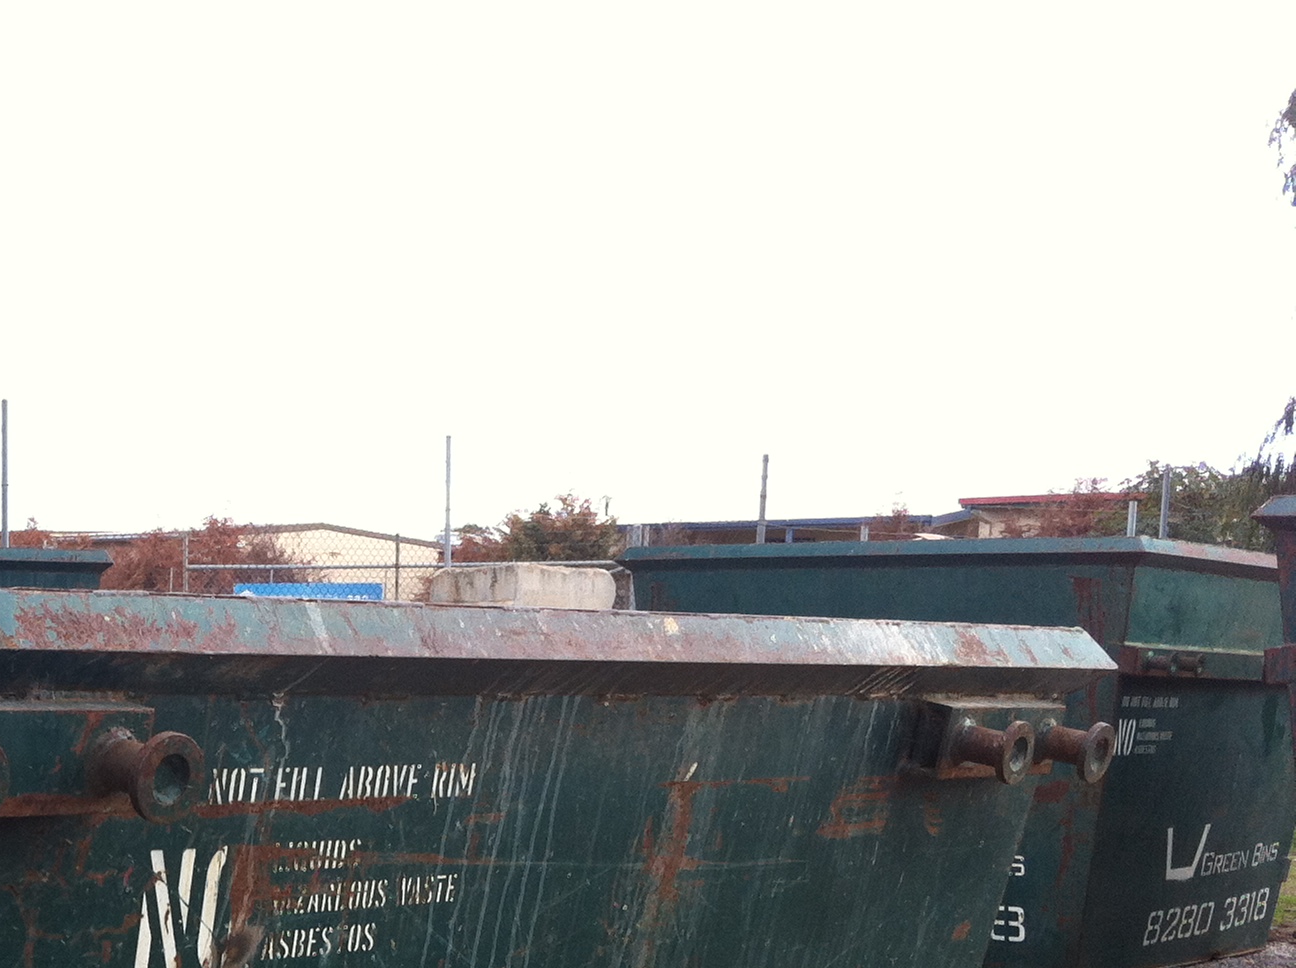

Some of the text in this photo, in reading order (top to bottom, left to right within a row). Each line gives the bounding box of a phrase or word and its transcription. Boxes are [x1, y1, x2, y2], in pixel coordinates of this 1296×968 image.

[208, 762, 476, 805] NOT FILL ABOVE RIM
[1200, 841, 1280, 876] GREEN BINS
[1142, 887, 1270, 946] 8280 3318
